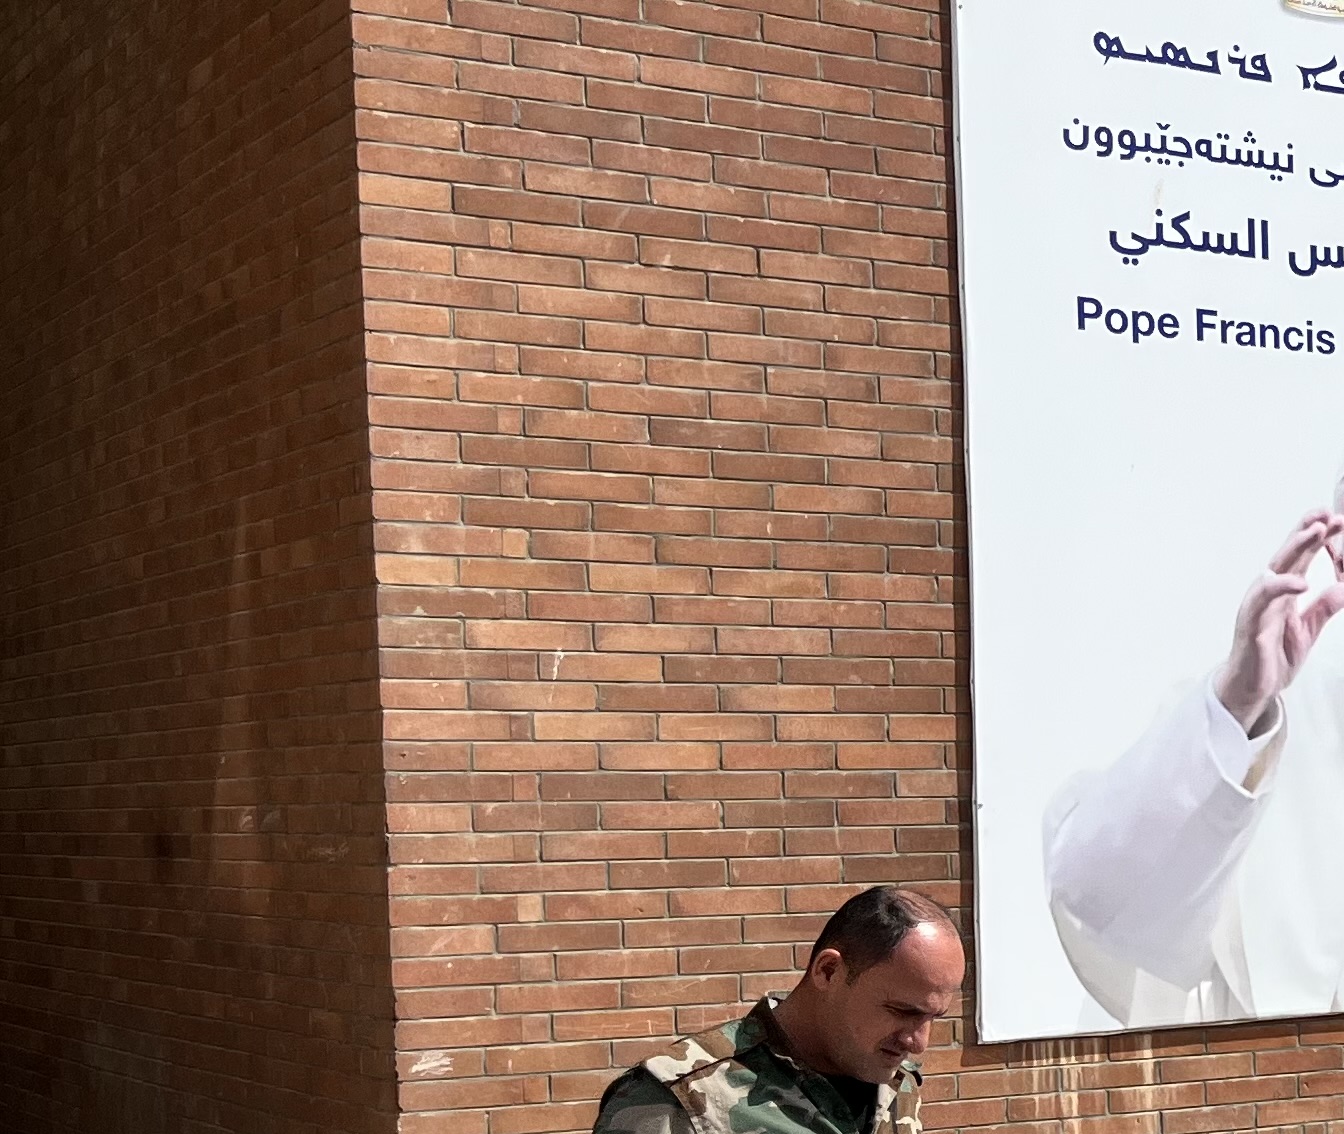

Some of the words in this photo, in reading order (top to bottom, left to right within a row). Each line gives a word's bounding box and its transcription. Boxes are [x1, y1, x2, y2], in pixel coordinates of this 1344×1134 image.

[1108, 208, 1270, 266] السكني
[1076, 295, 1180, 344] Pope
[1195, 308, 1336, 355] Francis
